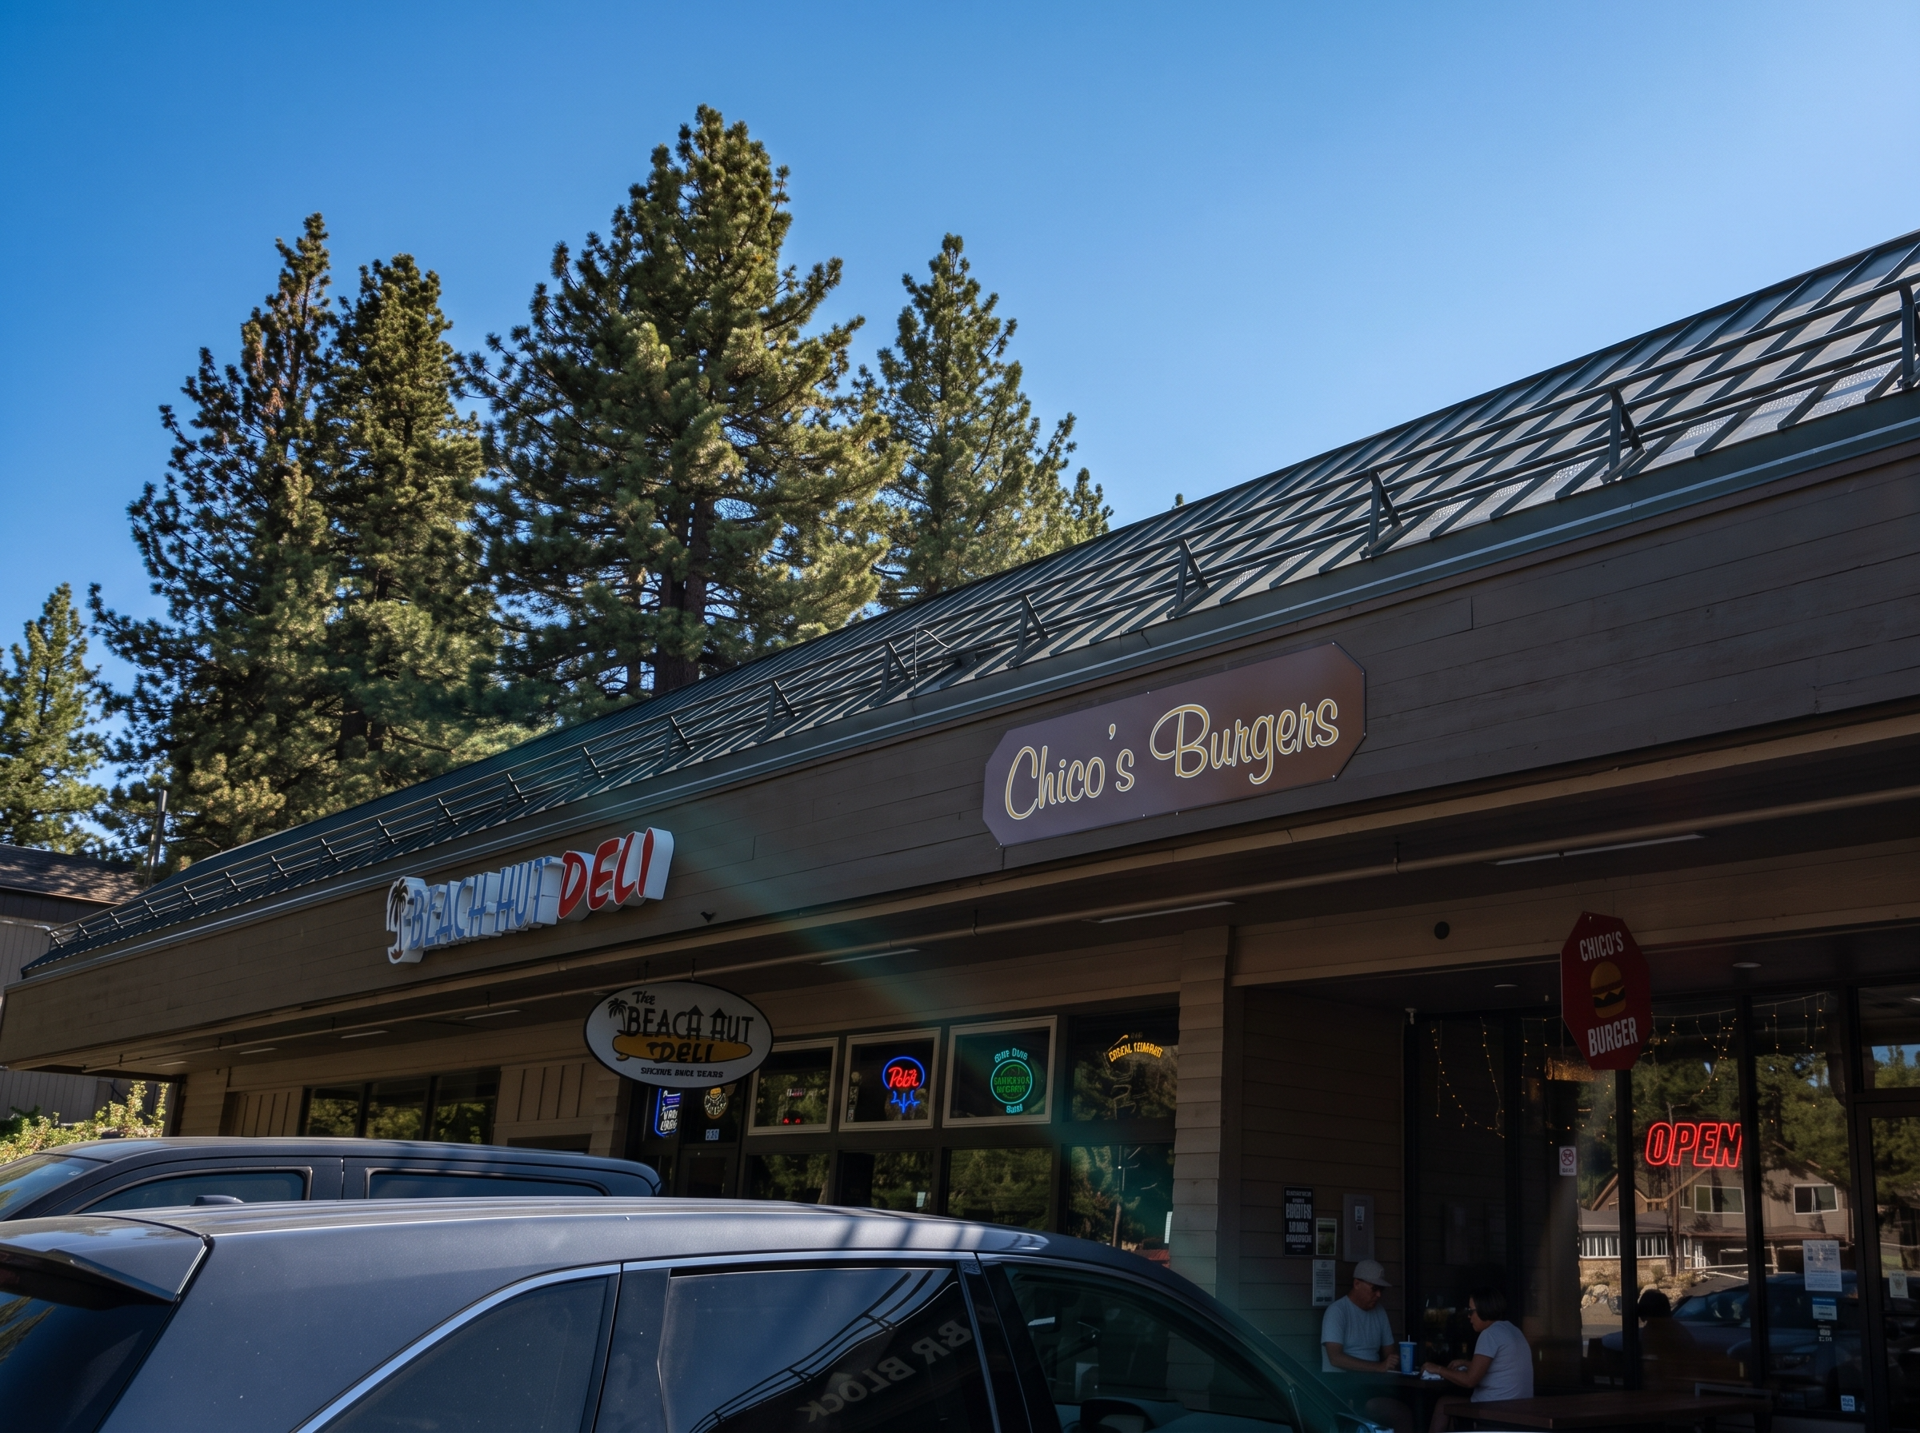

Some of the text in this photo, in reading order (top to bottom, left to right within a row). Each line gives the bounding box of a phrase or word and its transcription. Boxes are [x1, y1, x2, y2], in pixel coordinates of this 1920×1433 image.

[1004, 699, 1340, 820] Chico's Burgers
[407, 828, 667, 950] BEACH HUT DELI
[1579, 930, 1624, 962] CHICO'S
[627, 1005, 754, 1044] BEACH HUT
[1587, 1017, 1639, 1058] BURGER
[1645, 1122, 1743, 1168] OPEN
